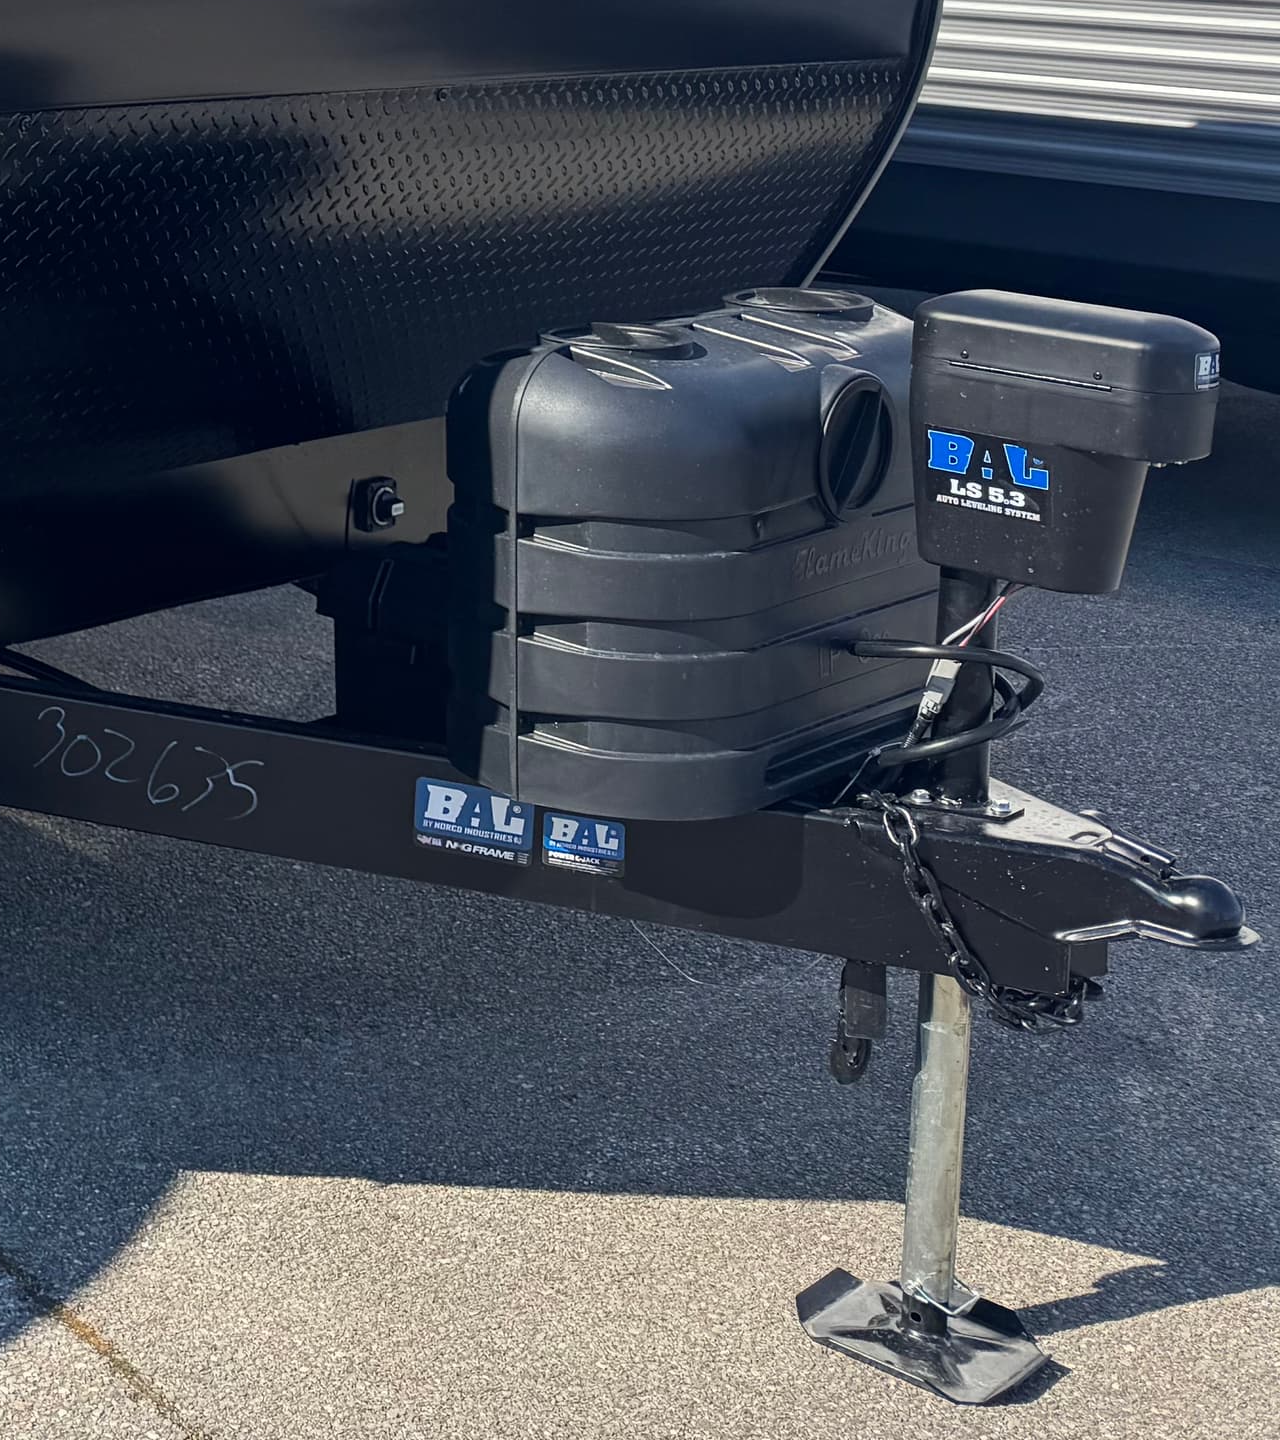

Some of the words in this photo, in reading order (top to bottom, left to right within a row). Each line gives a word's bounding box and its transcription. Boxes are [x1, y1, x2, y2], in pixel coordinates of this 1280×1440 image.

[927, 429, 1049, 491] BAL
[936, 494, 959, 505] AUTO
[960, 498, 1003, 514] LEVELING
[1004, 507, 1041, 522] SYSTEM
[950, 478, 982, 499] LS
[988, 486, 1026, 508] 5.3
[424, 784, 526, 836] BAL
[423, 819, 433, 829] BY
[434, 822, 463, 833] NORCO
[550, 817, 620, 850] BAL
[472, 845, 515, 861] FRAME
